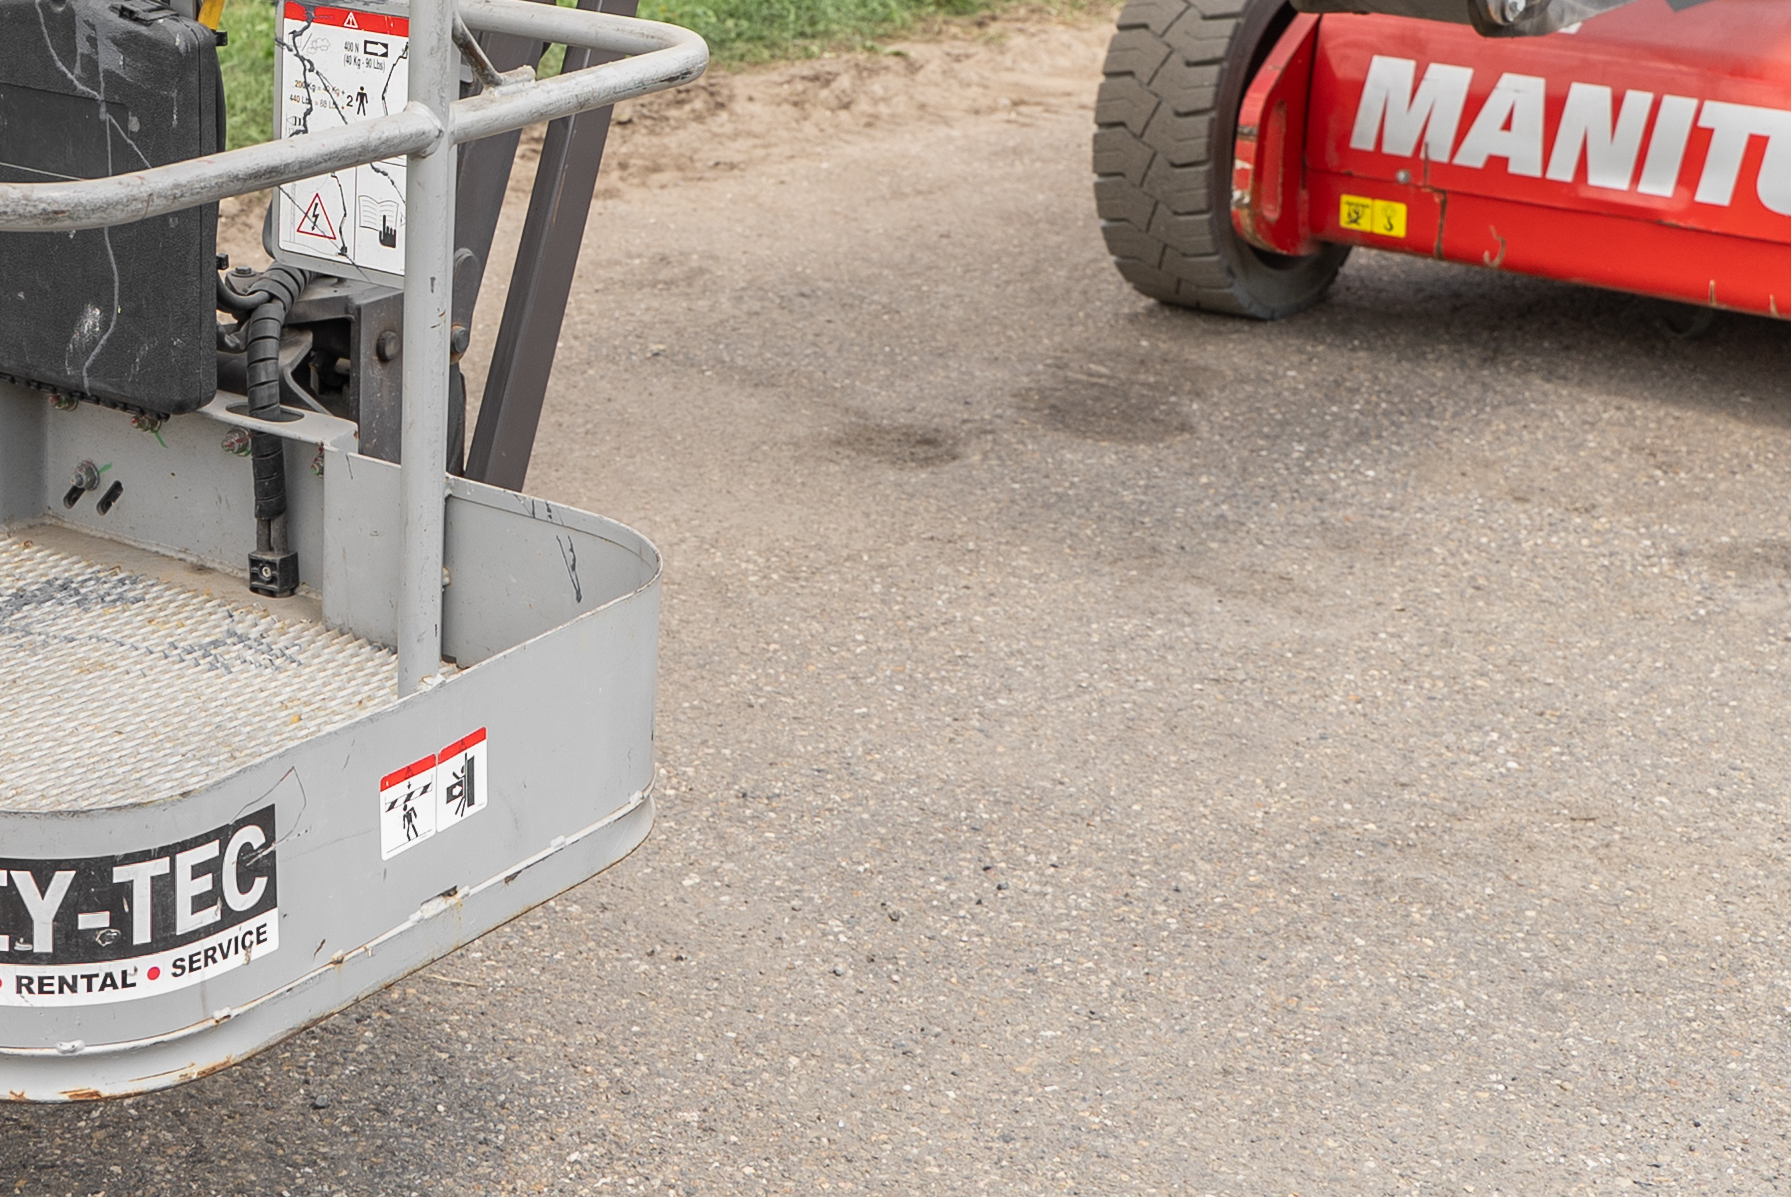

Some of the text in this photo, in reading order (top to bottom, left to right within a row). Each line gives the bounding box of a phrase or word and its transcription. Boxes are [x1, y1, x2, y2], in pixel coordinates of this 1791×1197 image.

[344, 41, 354, 52] 400
[353, 56, 361, 69] Kg
[366, 57, 372, 69] 90
[346, 94, 354, 107] 2
[15, 969, 137, 995] RENTAL
[170, 923, 268, 978] SERVICE
